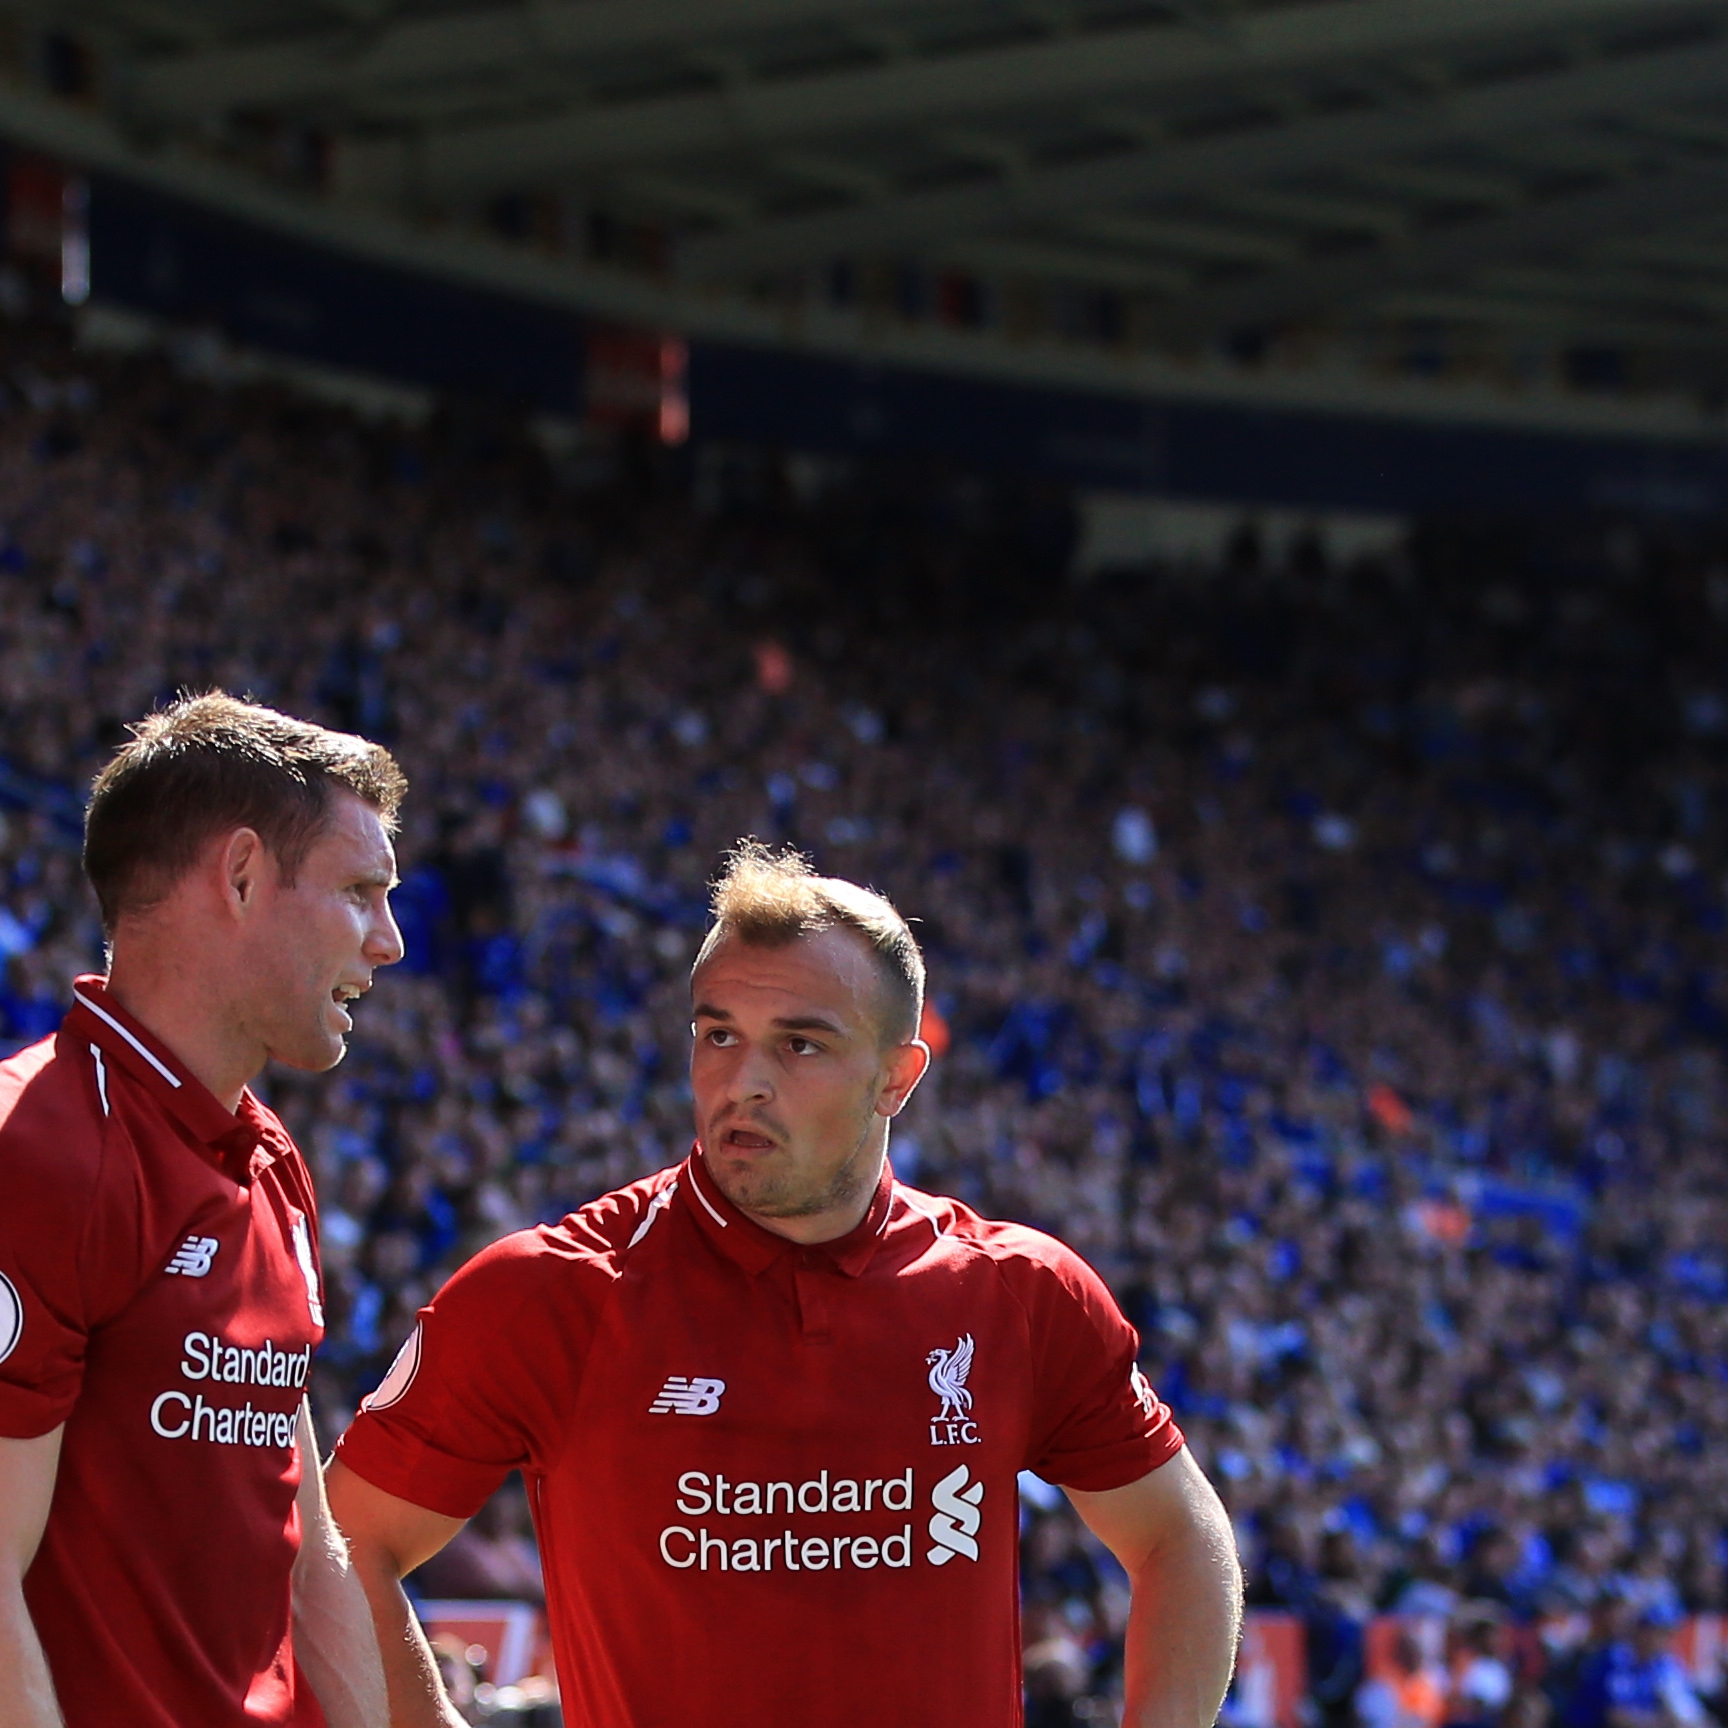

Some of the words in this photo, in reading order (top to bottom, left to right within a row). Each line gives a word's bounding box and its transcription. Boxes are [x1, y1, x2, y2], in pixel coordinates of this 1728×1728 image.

[181, 1331, 310, 1389] Standard
[150, 1390, 302, 1449] Chartered
[930, 1421, 982, 1446] L.F.C.
[676, 1467, 913, 1516] Standard
[659, 1524, 912, 1571] Chartered
